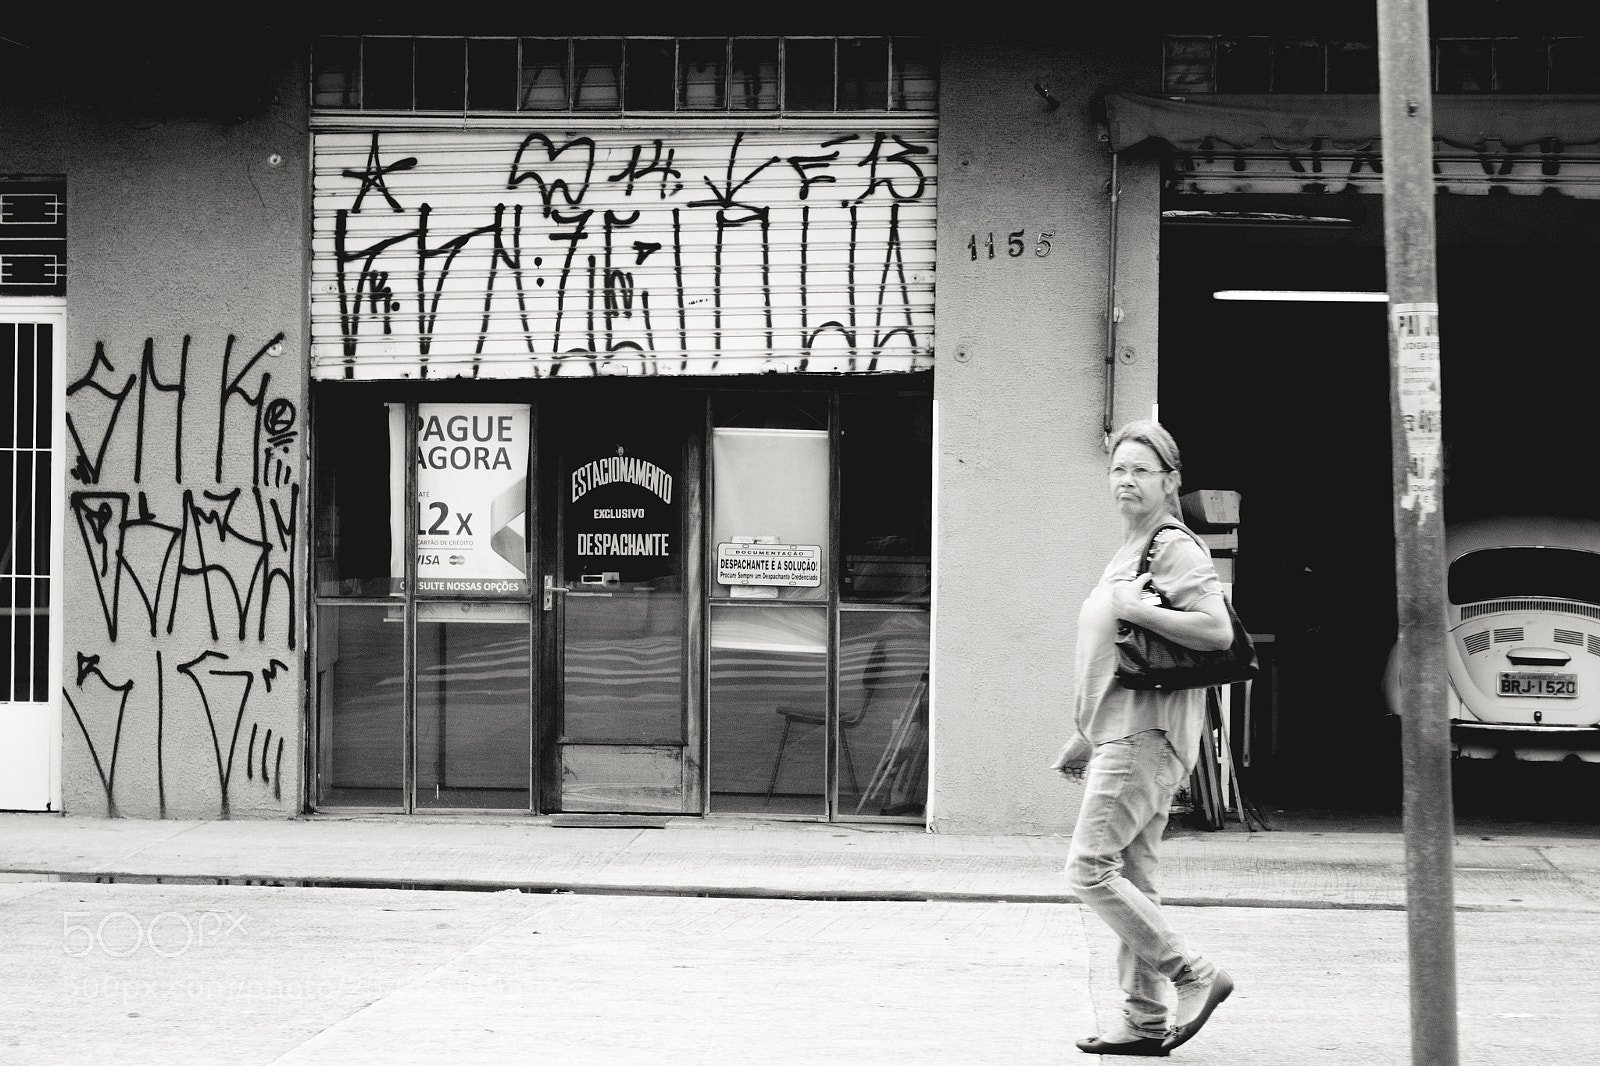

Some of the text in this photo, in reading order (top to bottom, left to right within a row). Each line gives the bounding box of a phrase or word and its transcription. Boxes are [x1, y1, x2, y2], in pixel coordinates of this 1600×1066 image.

[967, 229, 1055, 261] 1155
[572, 456, 672, 505] ESTACIONAMENTO
[593, 508, 645, 519] EXCLUSIVO
[577, 533, 669, 556] DESPACHANTE
[720, 559, 769, 570] DESPACHANTE
[784, 559, 818, 573] SOLUÇÃO!
[737, 572, 754, 580] Sempre
[446, 582, 482, 591] NOSSAS
[483, 581, 519, 592] OPÇÕES
